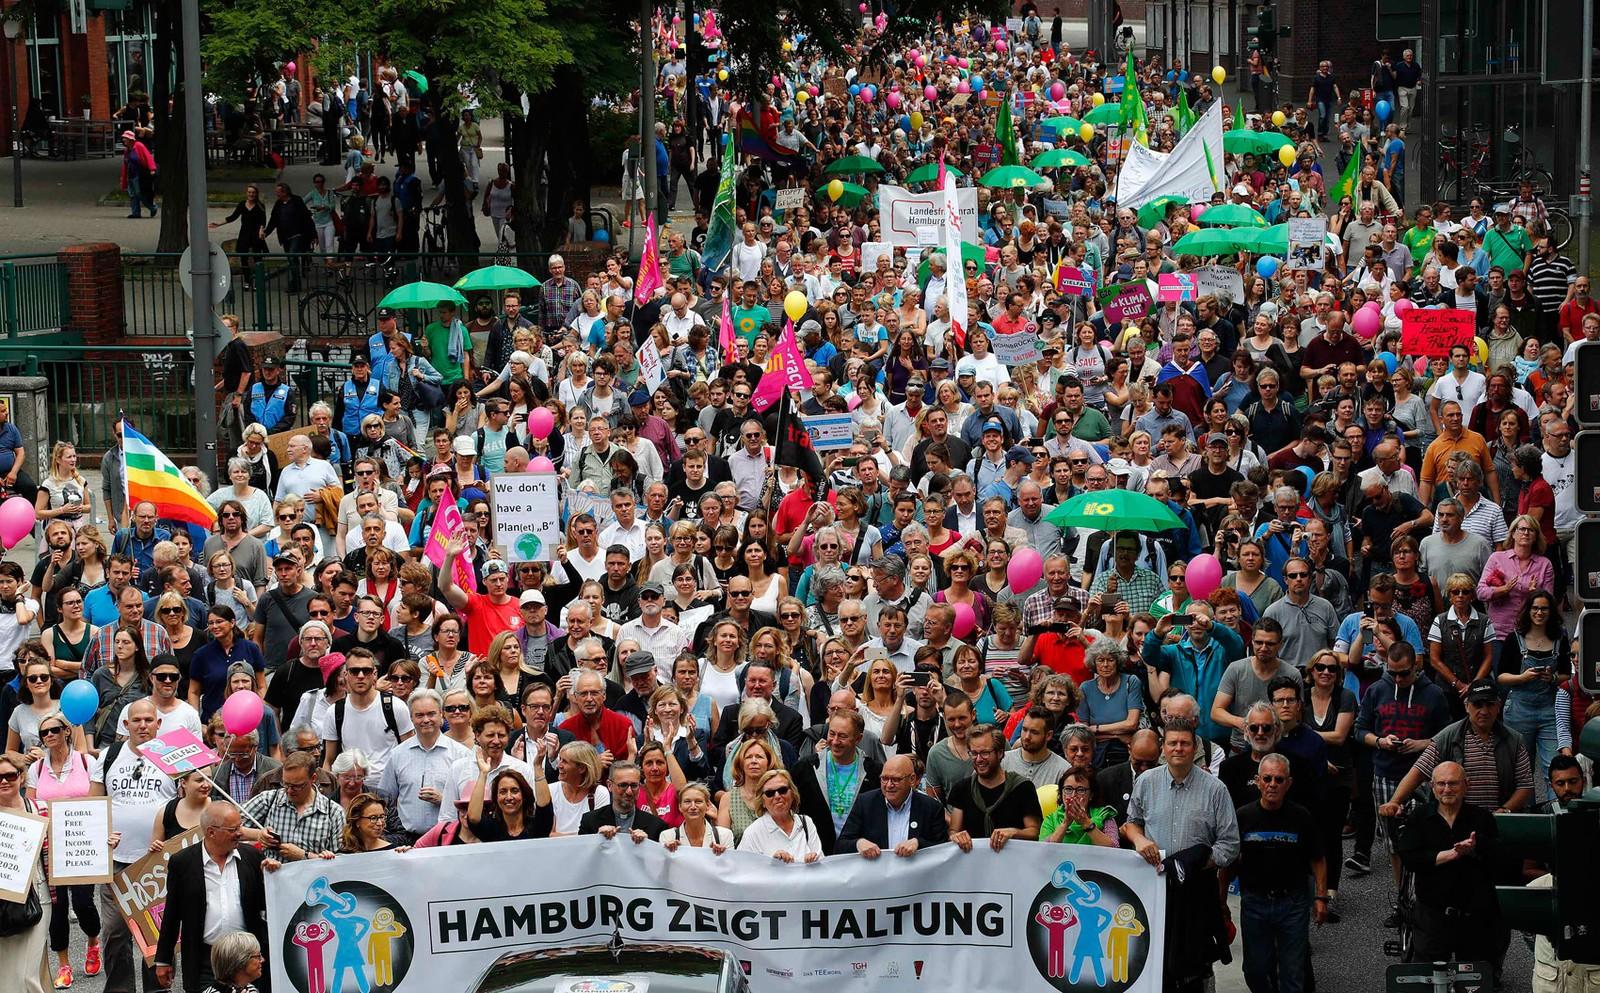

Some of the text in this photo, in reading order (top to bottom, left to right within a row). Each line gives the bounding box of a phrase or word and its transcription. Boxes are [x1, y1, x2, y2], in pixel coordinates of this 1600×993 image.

[910, 206, 974, 216] Landesfrnrat
[908, 216, 945, 226] Hamburg
[1063, 279, 1091, 288] VIELFALT
[1119, 293, 1149, 307] KLIMA-
[1079, 357, 1097, 367] SAVE
[495, 482, 546, 493] We don't
[496, 503, 533, 513] have a
[497, 522, 535, 532] Plan(et)
[1379, 703, 1425, 716] NEVER
[162, 744, 200, 764] VIELFALT
[111, 778, 162, 792] S.OLIVER
[121, 791, 150, 799] BRAND
[438, 895, 1004, 944] HAMBURG ZEIGT HALTUNG
[851, 962, 867, 970] TGH
